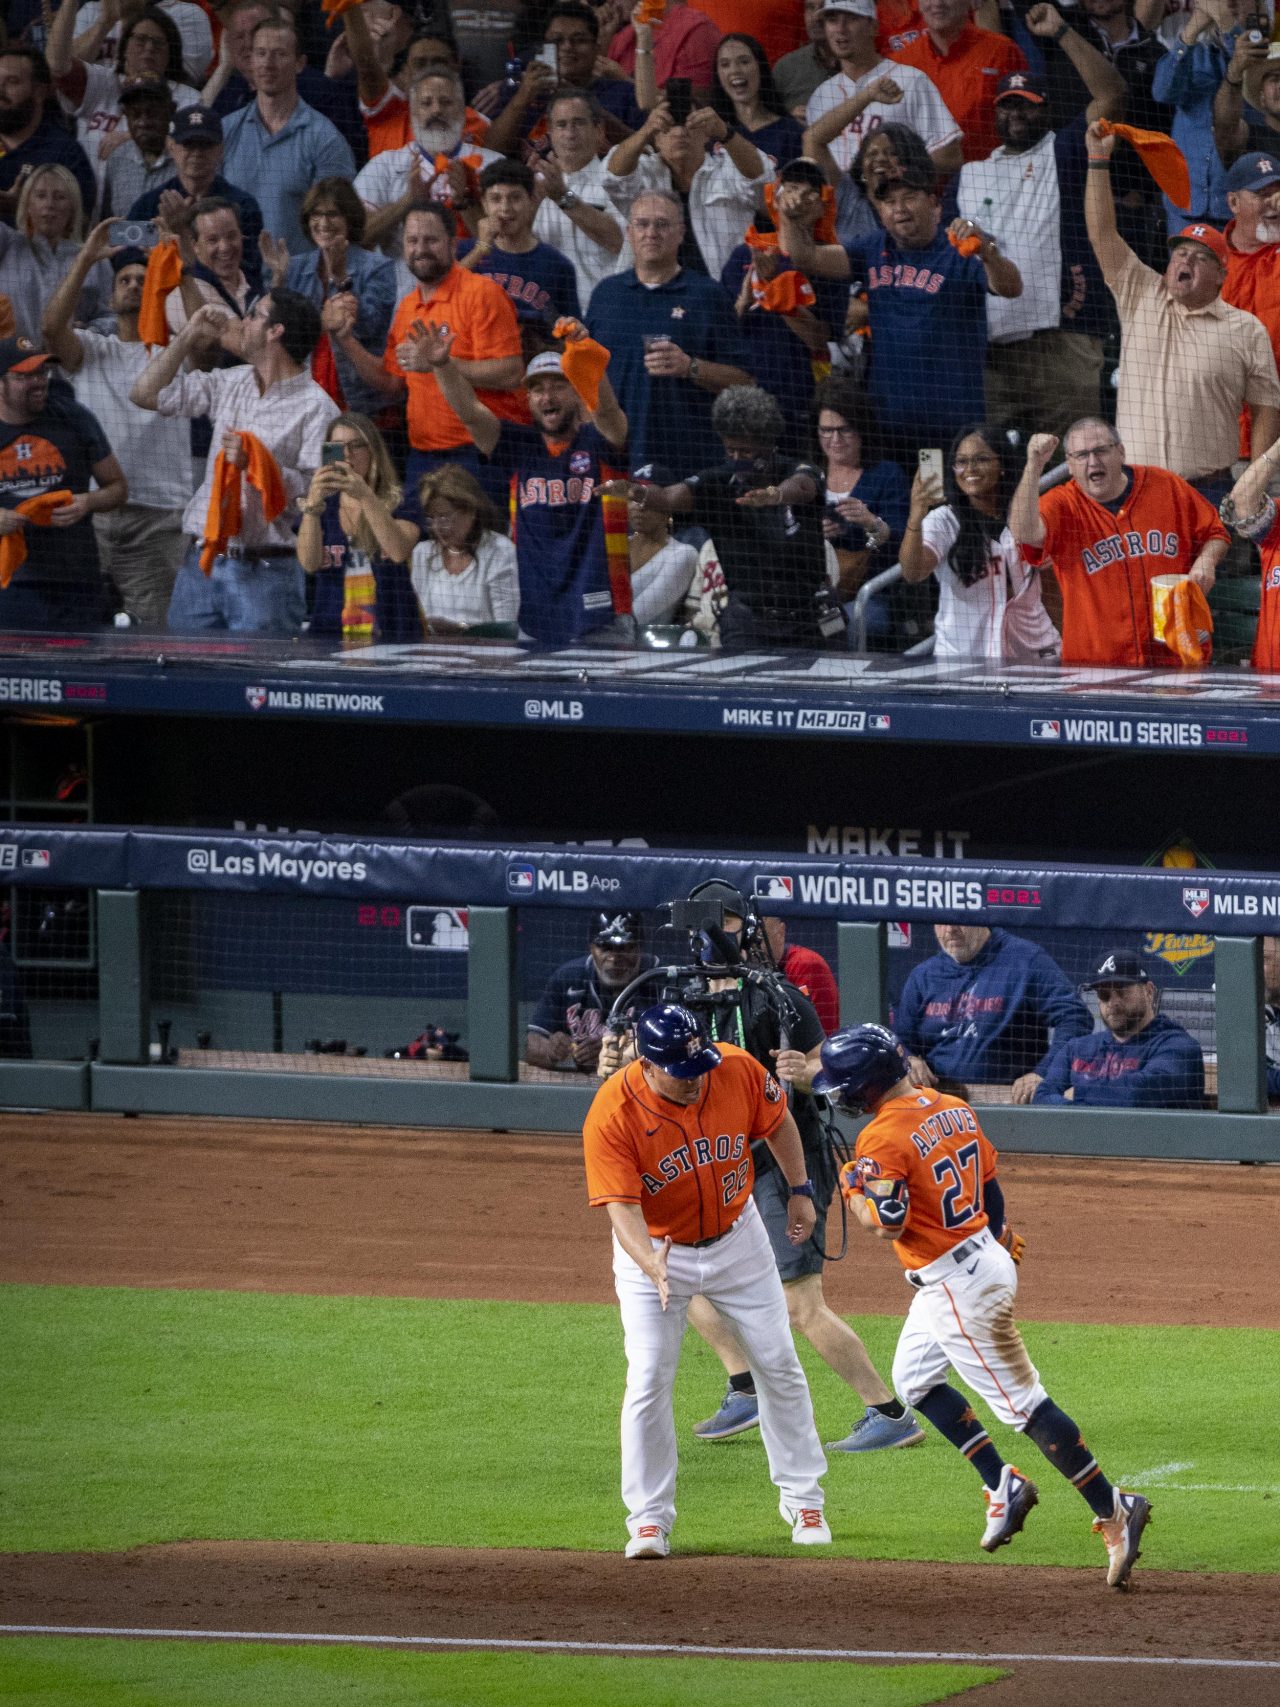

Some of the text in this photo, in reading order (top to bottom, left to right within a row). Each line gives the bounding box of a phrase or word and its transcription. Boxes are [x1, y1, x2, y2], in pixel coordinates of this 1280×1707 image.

[868, 264, 945, 294] ASTROS
[519, 477, 596, 508] ASTROS
[1082, 529, 1179, 575] ASTROS
[0, 677, 63, 704] SERIES
[268, 691, 385, 712] MLB NETWORK
[524, 699, 584, 721] @MLB
[723, 708, 861, 729] MAKE IT MAJOR
[1063, 719, 1132, 743] WORLD
[1136, 722, 1202, 745] SERIES
[807, 824, 971, 860] MAKE IT
[187, 848, 367, 885] @Las Mayores
[537, 869, 619, 892] MLB App
[799, 875, 1041, 911] WORLD SERIES 2021
[1214, 894, 1258, 915] MLB
[910, 1106, 977, 1160] ALTUVE
[640, 1133, 745, 1196] ASTROS
[721, 1157, 750, 1207] 22
[931, 1137, 981, 1229] 27
